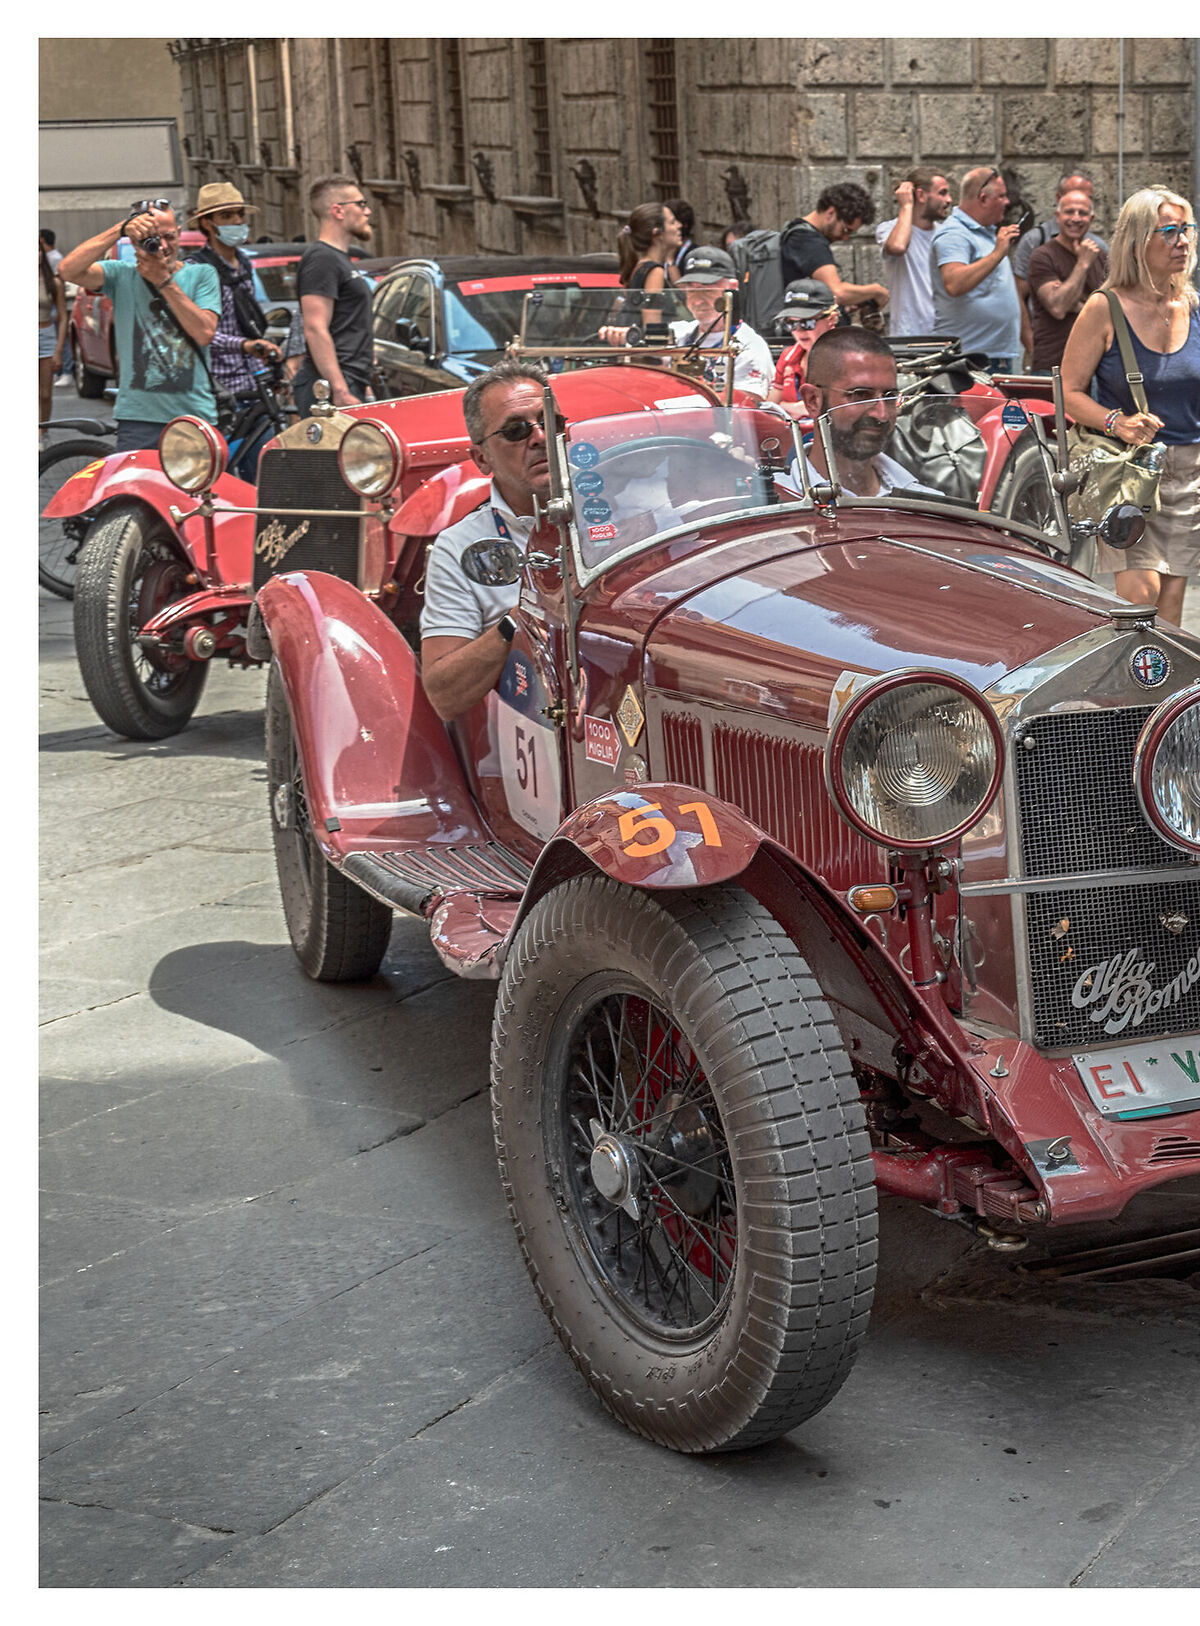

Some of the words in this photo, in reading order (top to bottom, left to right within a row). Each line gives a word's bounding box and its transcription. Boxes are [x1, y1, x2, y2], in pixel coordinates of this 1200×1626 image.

[588, 721, 611, 741] 1000
[588, 740, 614, 761] MIGLIA
[515, 725, 538, 798] 51
[618, 802, 722, 858] 51
[1071, 948, 1156, 1023] Alfa
